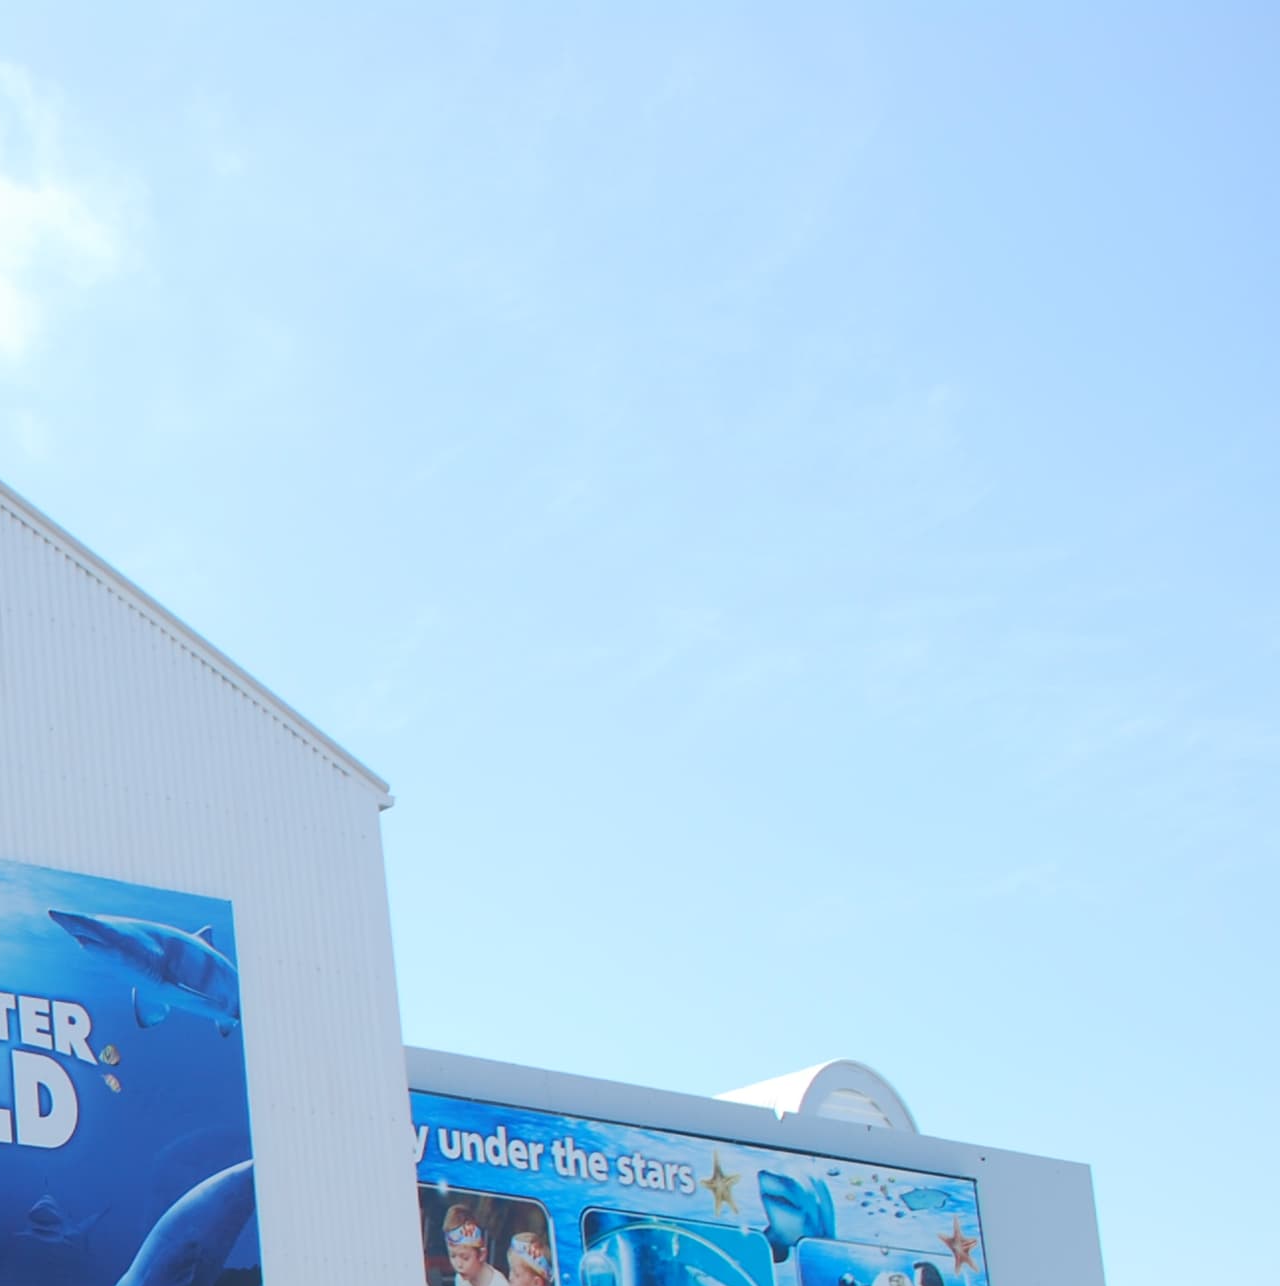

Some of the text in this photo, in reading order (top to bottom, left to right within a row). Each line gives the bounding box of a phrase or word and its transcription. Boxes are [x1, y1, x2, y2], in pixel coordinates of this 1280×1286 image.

[437, 1125, 543, 1171] under
[551, 1137, 608, 1182] the
[617, 1152, 696, 1194] stars
